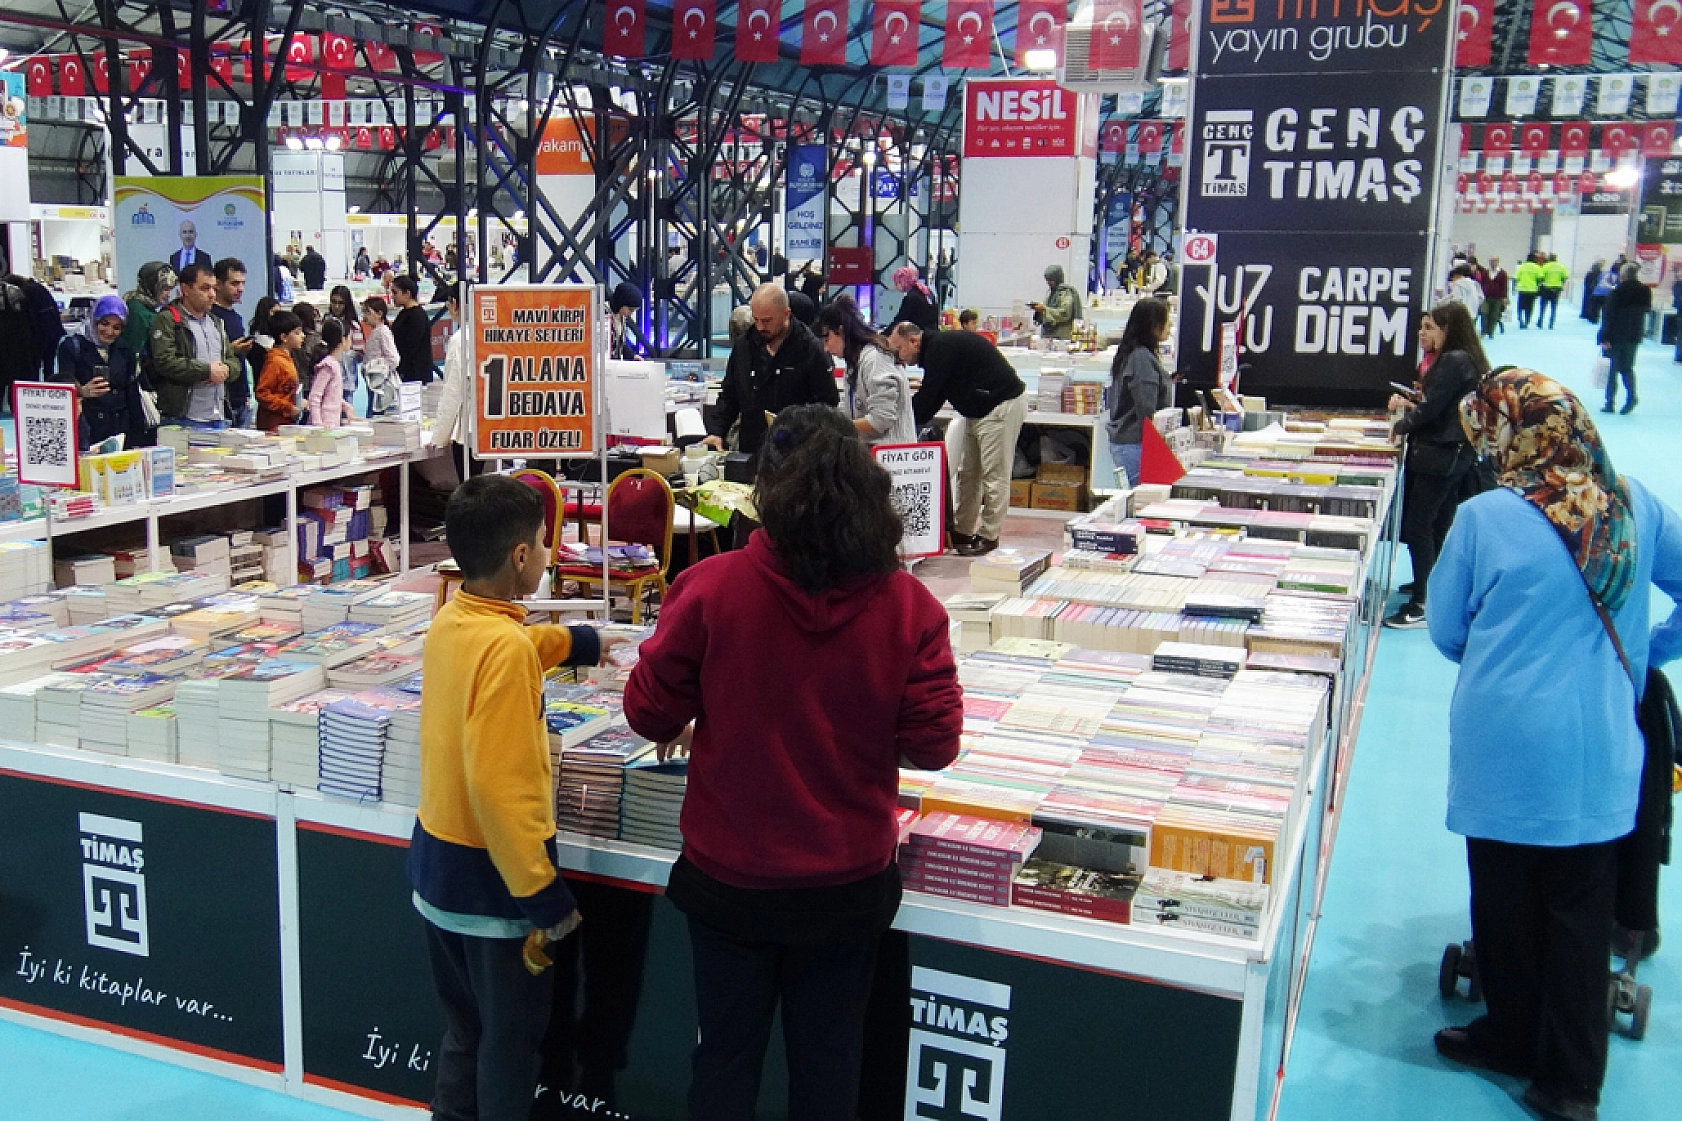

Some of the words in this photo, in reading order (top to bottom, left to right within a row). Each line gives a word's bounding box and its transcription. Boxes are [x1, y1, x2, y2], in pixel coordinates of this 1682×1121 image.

[1209, 27, 1299, 64] yayın
[1308, 9, 1408, 61] grubu
[1264, 105, 1426, 153] GENÇ
[537, 138, 585, 156] yakam
[1192, 240, 1209, 259] 64
[1298, 267, 1412, 302] CARPE
[512, 305, 549, 324] MAVİ
[551, 305, 585, 324] KİRPİ
[484, 325, 531, 343] HİKAYE
[534, 325, 585, 342] SETLERİ
[482, 356, 507, 417] 1
[509, 357, 586, 382] ALANA
[509, 391, 585, 416] BEDAVA
[491, 430, 534, 449] FUAR
[538, 427, 581, 449] ÖZEL!
[882, 451, 910, 463] FİYAT
[912, 449, 934, 461] GÖR
[80, 835, 145, 873] TİMAŞ
[16, 945, 47, 983] İyi
[53, 958, 73, 985] ki
[79, 964, 168, 1006] kitaplar
[175, 996, 233, 1022] var...
[909, 995, 1009, 1046] TİMAŞ
[362, 1026, 400, 1069] İyi
[407, 1043, 431, 1071] ki
